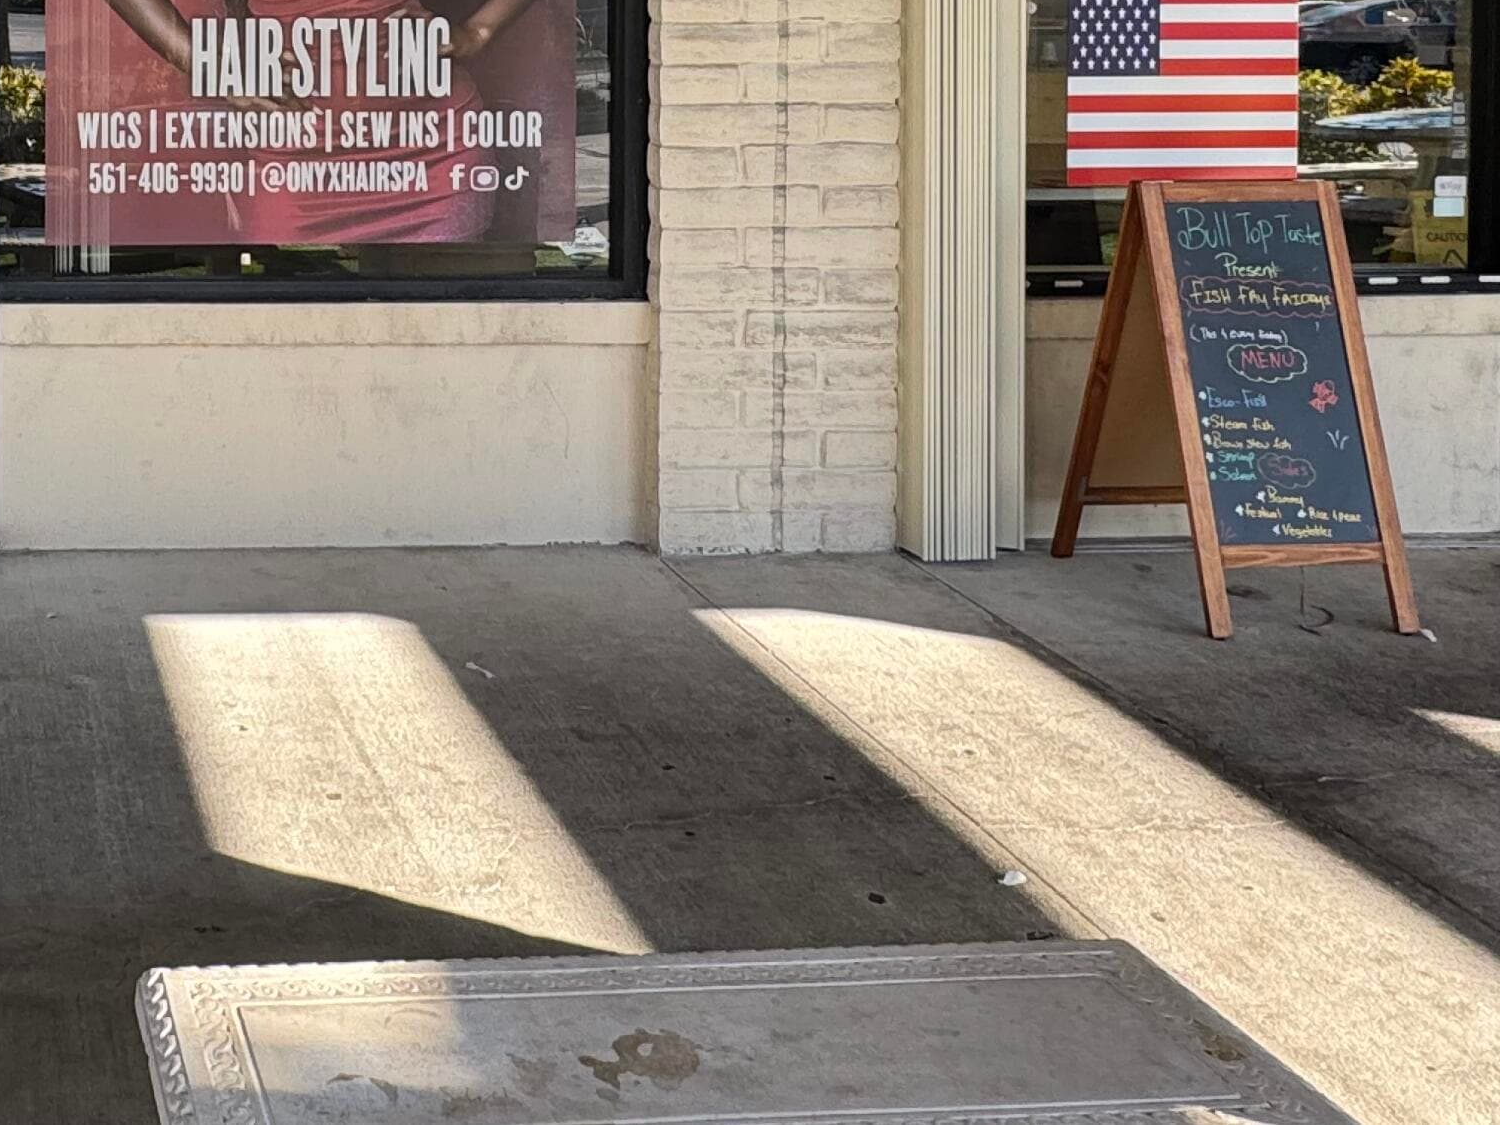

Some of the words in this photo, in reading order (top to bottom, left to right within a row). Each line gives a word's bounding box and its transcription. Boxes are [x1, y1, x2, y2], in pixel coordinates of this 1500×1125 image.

[191, 18, 283, 97] HAIR
[292, 17, 451, 98] STYLING
[77, 111, 142, 149] WIGS
[165, 111, 317, 149] EXTENSIONS
[340, 111, 392, 148] SEW
[399, 111, 440, 148] INS
[463, 110, 542, 148] COLOR
[89, 162, 243, 194] 561-406-9930
[261, 161, 428, 193] @ONYXHAIRSPA
[1177, 207, 1231, 250] Bull
[1236, 212, 1273, 254] Top
[1274, 213, 1322, 246] Taste
[1426, 231, 1468, 242] CAUTIO
[1214, 252, 1284, 279] Present
[1241, 350, 1296, 370] MENU
